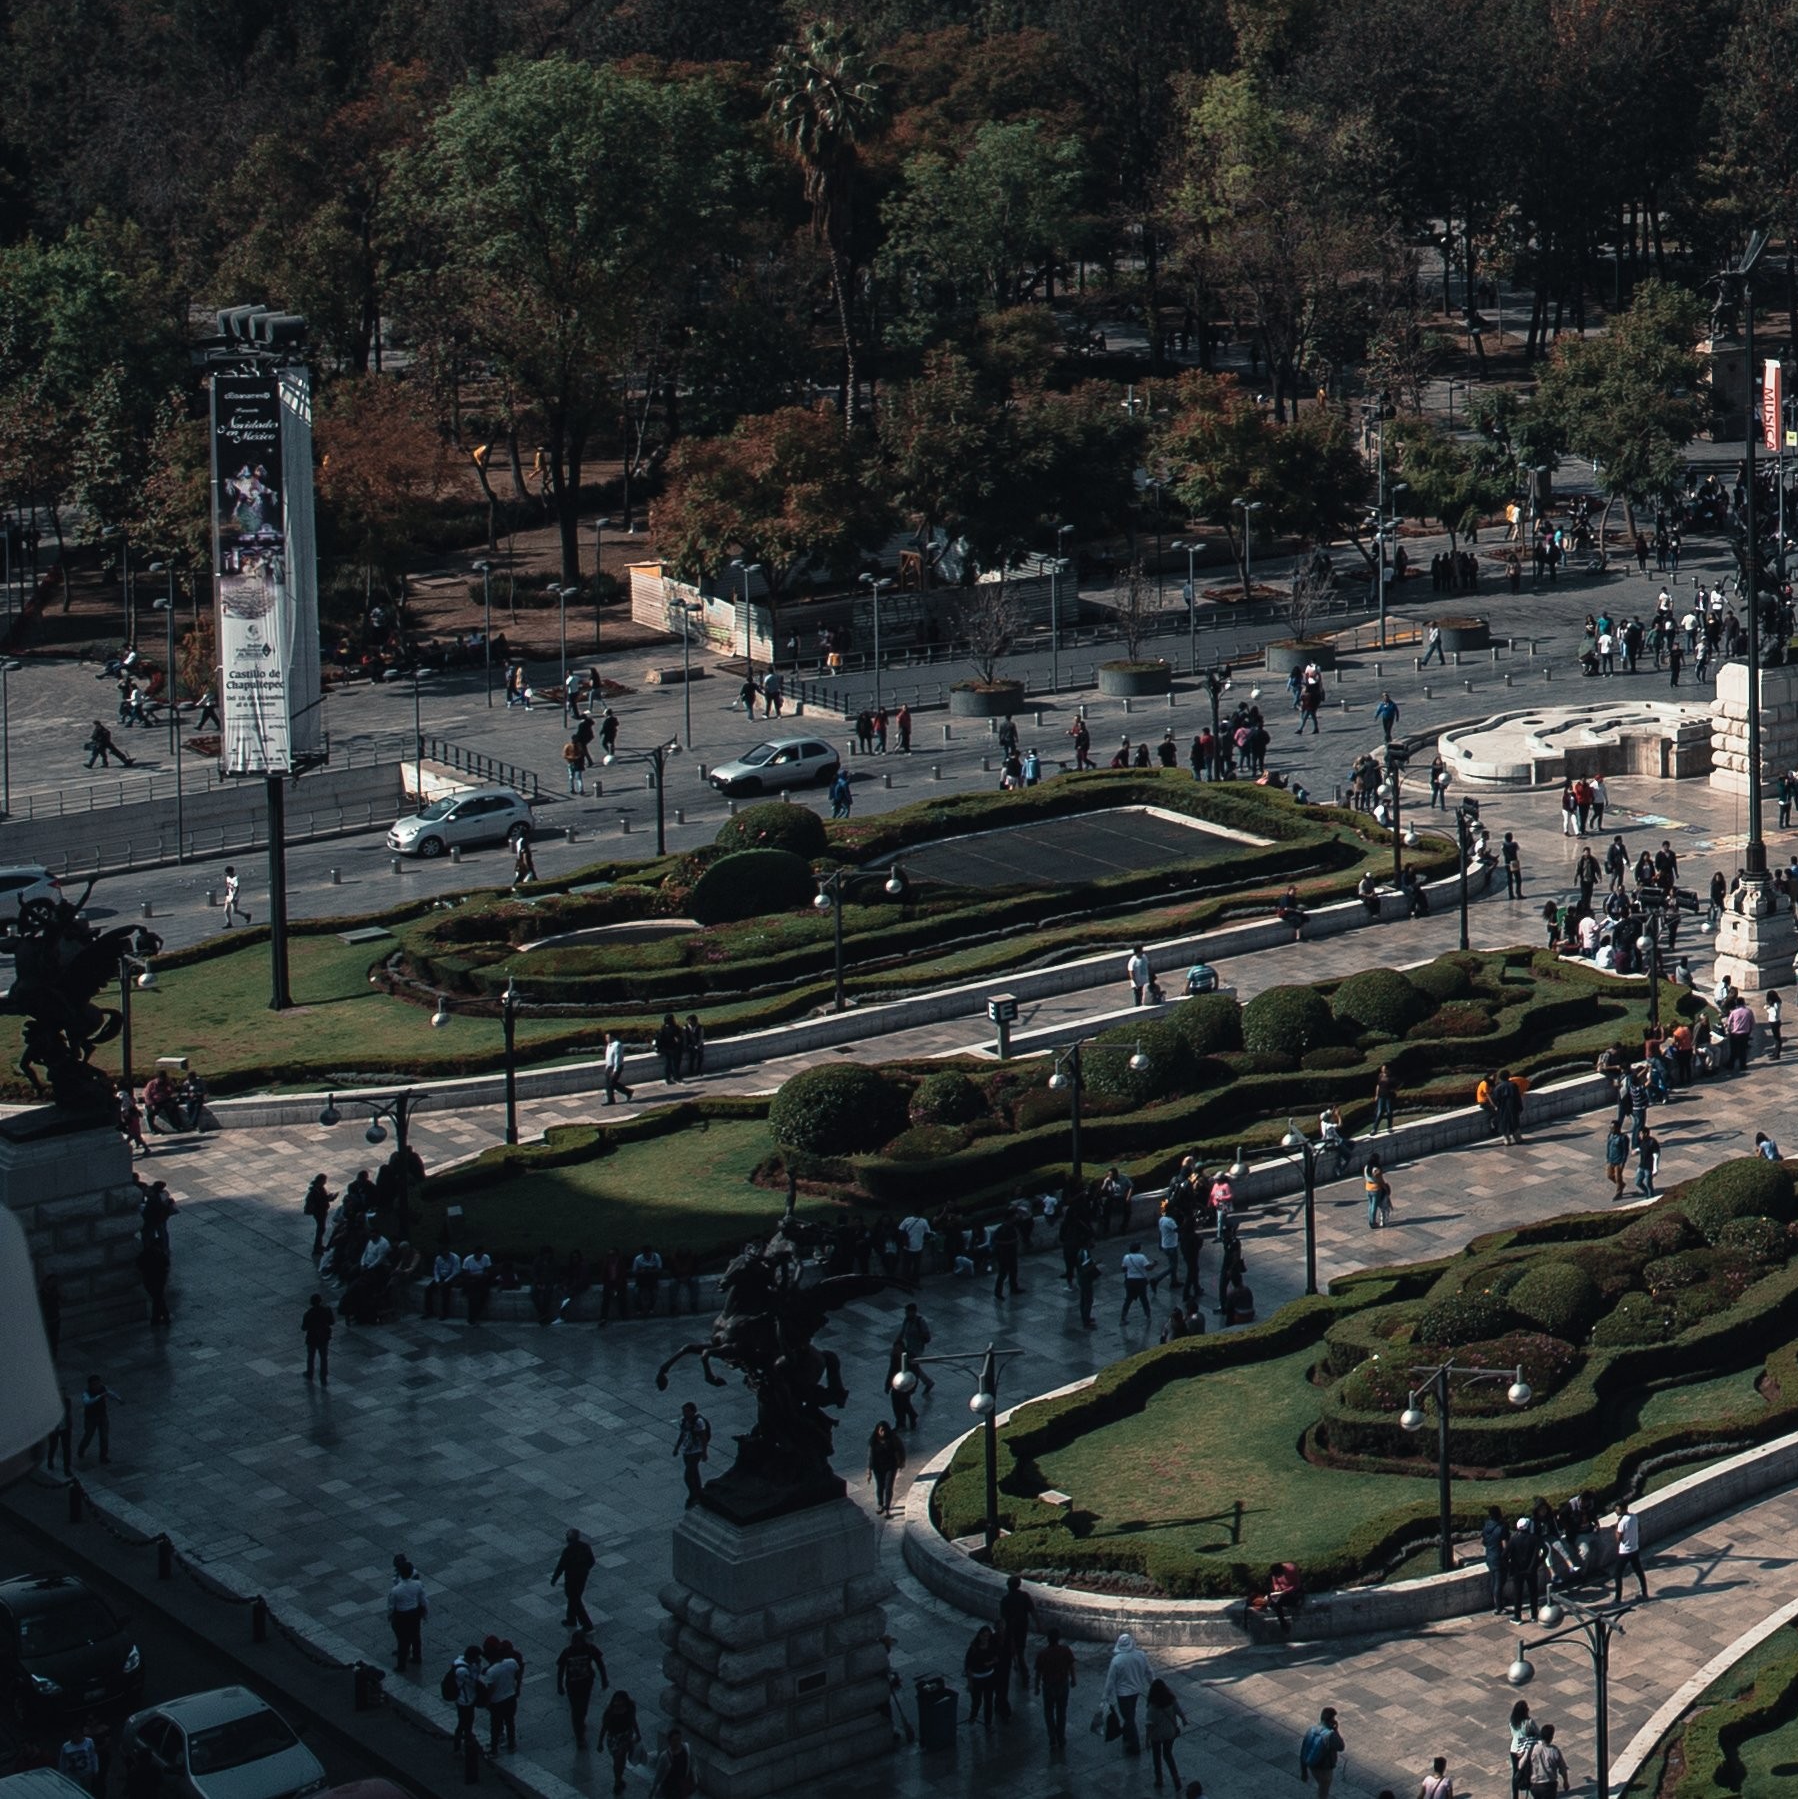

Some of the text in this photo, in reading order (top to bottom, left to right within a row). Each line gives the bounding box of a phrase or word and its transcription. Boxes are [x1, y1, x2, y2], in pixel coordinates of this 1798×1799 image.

[229, 669, 280, 679] Castillo de
[226, 680, 285, 691] Chapultepec
